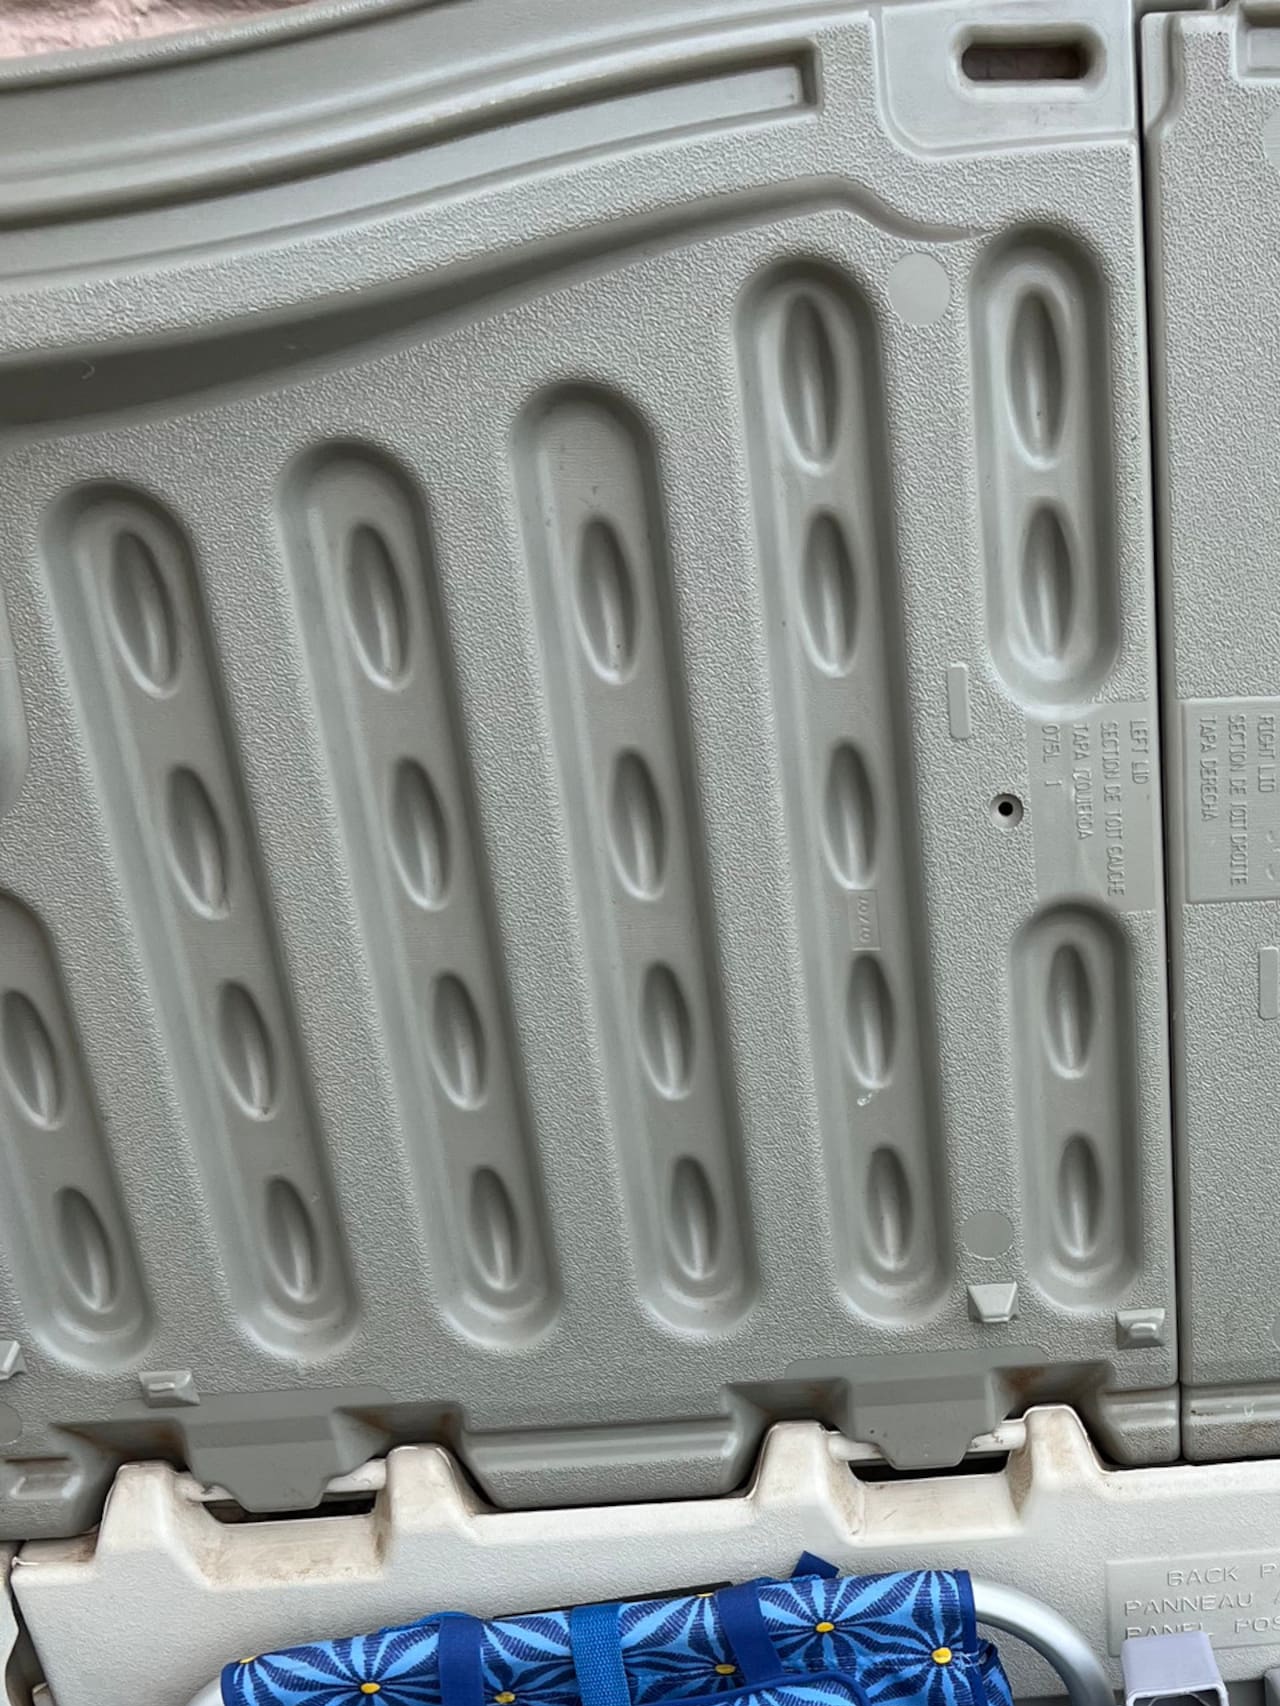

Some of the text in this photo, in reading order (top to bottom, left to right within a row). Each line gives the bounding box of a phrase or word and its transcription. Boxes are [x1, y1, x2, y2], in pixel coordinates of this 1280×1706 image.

[1072, 723, 1090, 761] TAPA
[1129, 718, 1150, 785] LEFT LID
[1200, 714, 1218, 822] TAPA DERECHA
[1257, 714, 1276, 793] RIGHT LID
[1101, 719, 1125, 897] SECTION DE TOIT GAUCHE
[1228, 713, 1248, 887] SECTION DE TOIT DROITE
[1124, 1592, 1254, 1617] PANNEAU
[1166, 1564, 1240, 1587] BACK
